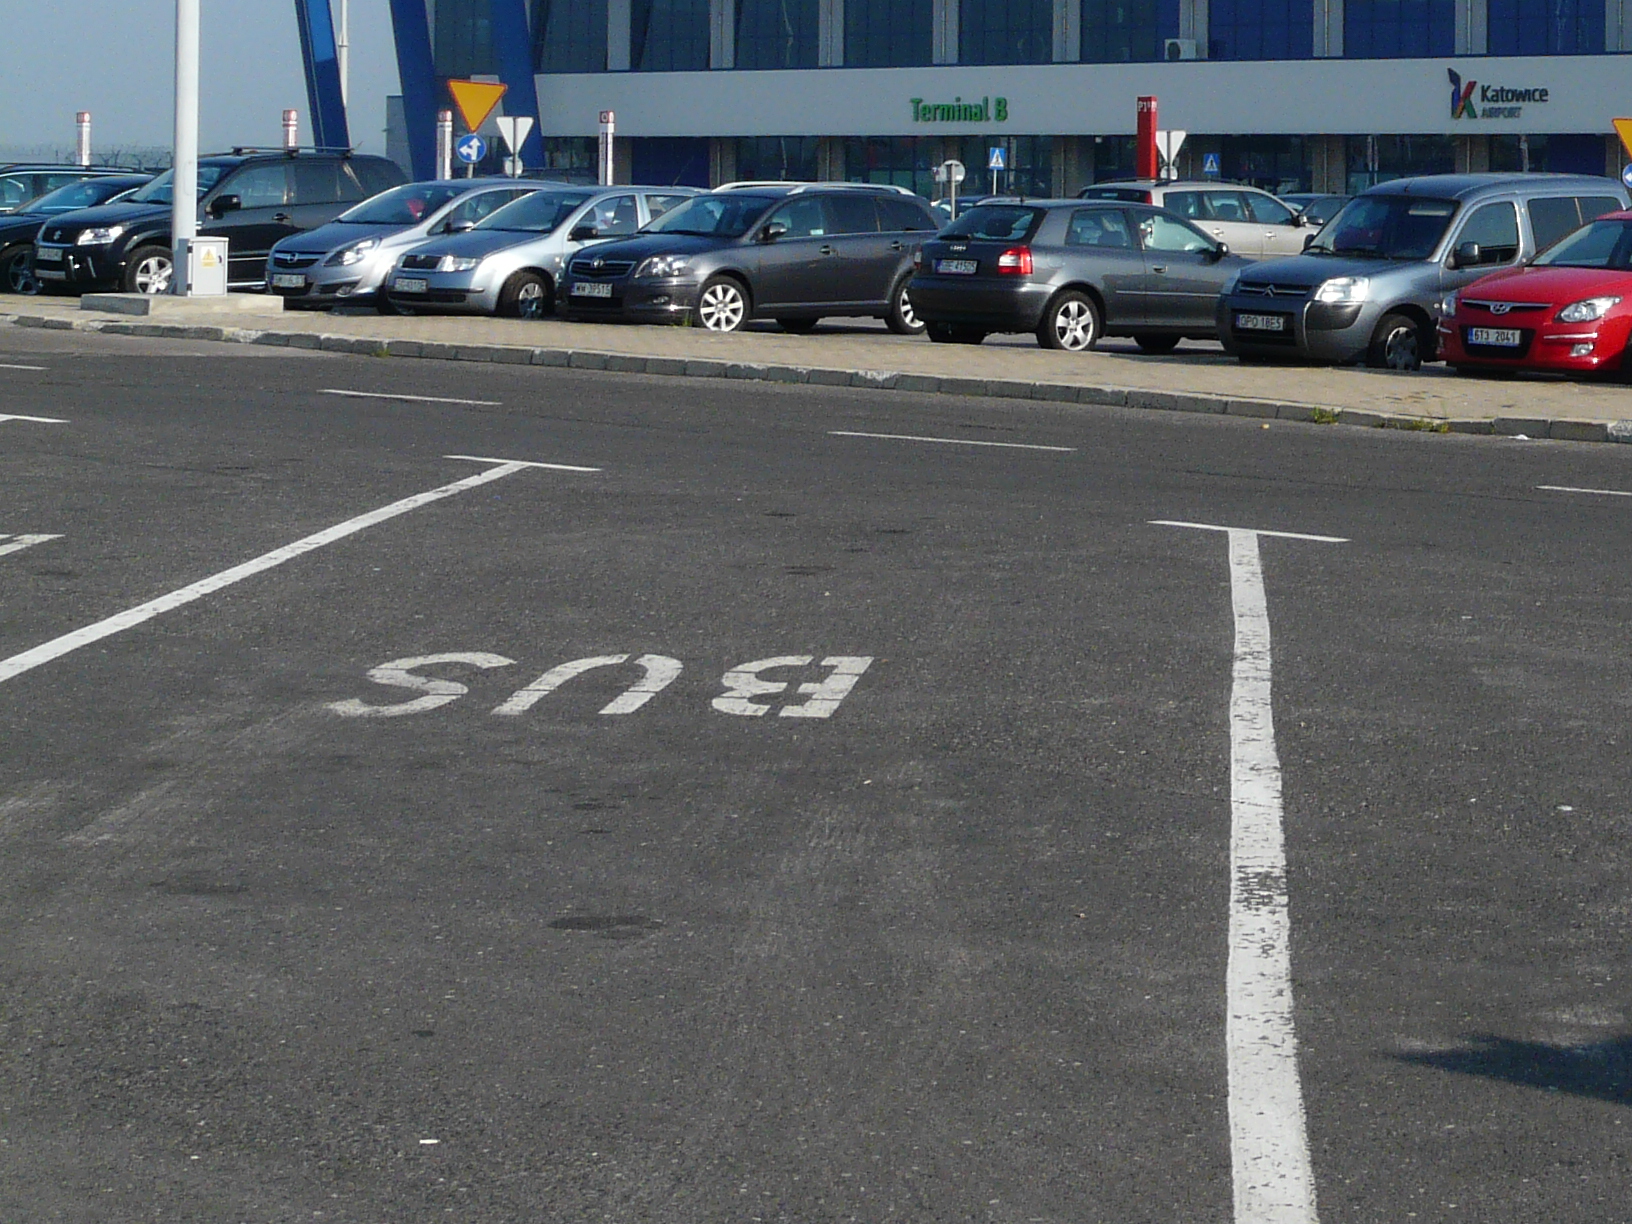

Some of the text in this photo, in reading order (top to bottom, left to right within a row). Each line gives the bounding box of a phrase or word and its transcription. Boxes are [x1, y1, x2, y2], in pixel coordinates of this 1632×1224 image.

[1481, 85, 1549, 103] Katowice
[910, 95, 1008, 123] Terminal B
[1481, 107, 1523, 119] AIRPORT
[1495, 331, 1516, 343] 2041
[322, 651, 876, 719] BUS
